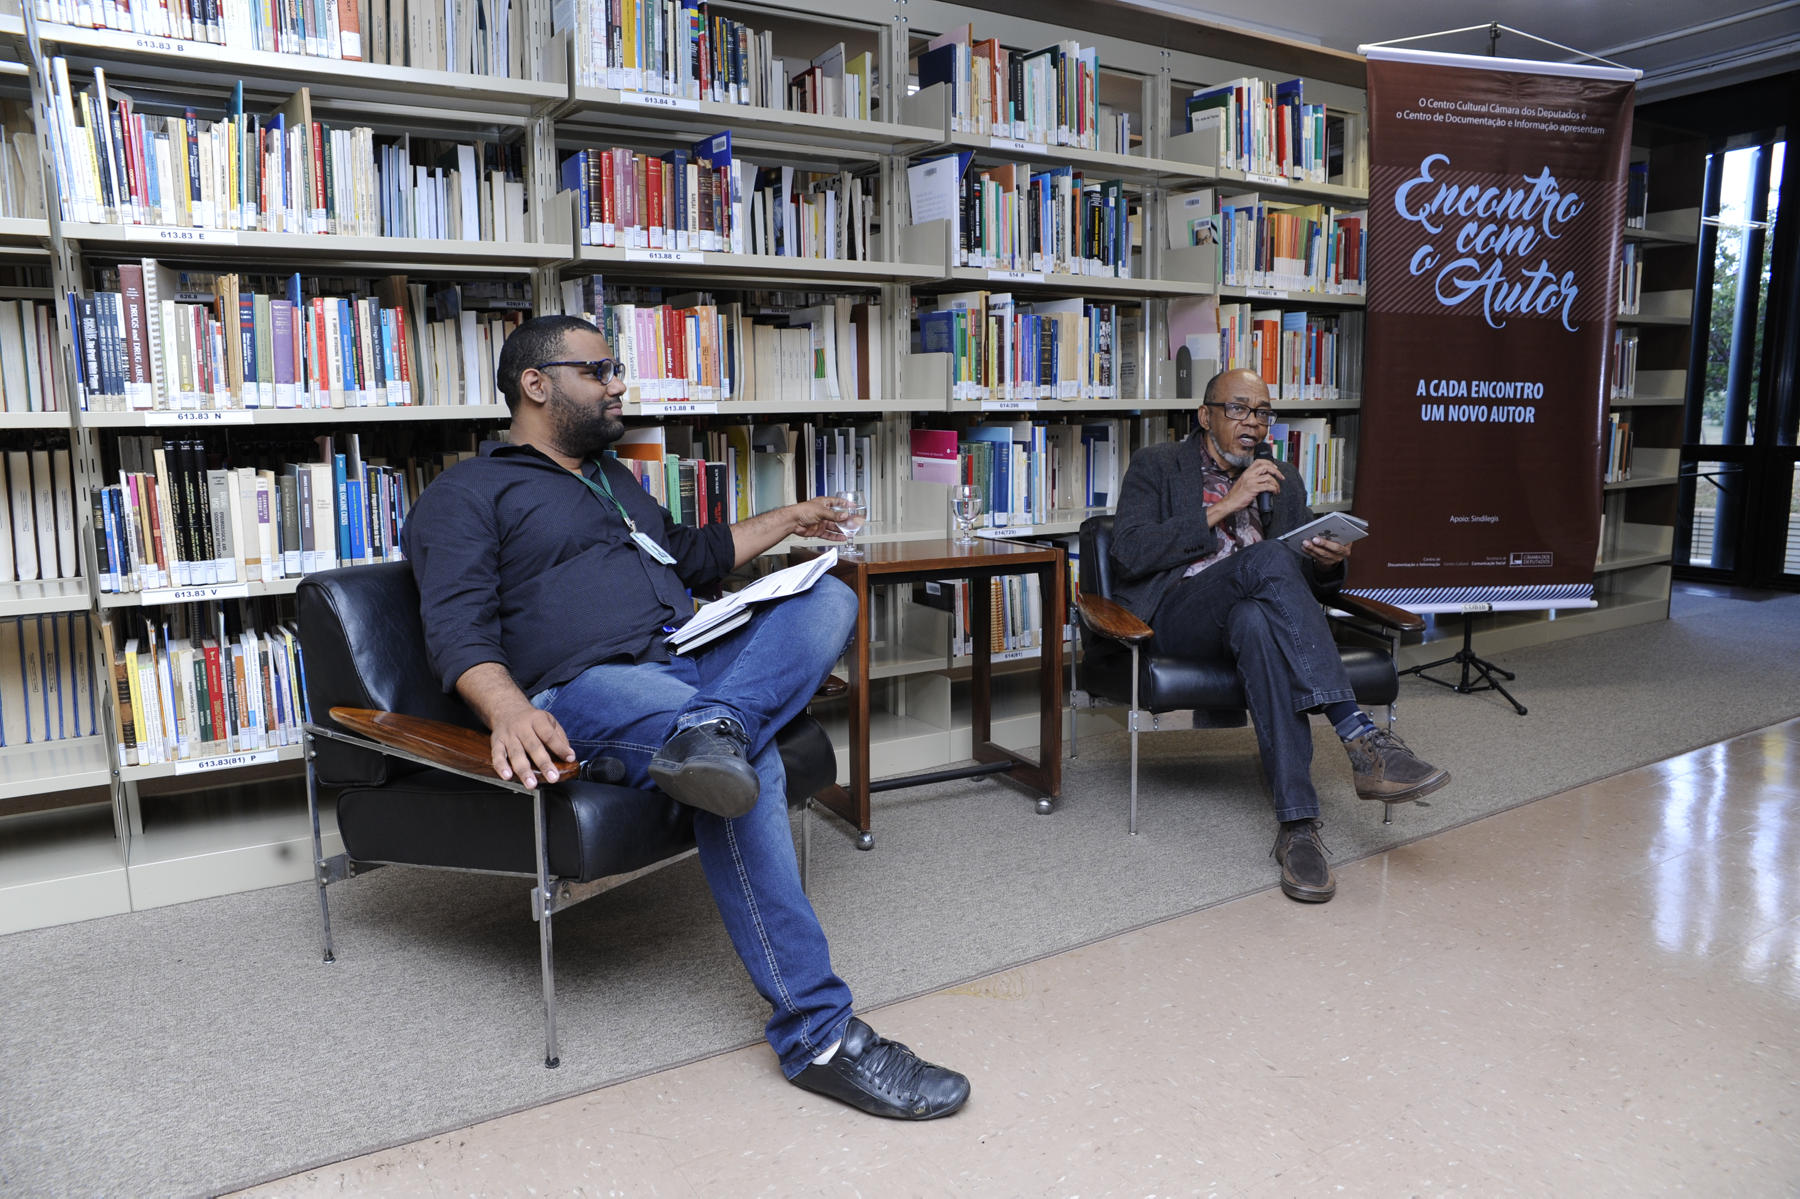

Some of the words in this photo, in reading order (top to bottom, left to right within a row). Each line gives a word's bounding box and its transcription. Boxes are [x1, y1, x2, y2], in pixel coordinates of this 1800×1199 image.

[136, 39, 171, 50] 613.83
[177, 44, 184, 52] B
[644, 97, 668, 105] 613.84
[1418, 98, 1426, 107] O
[1427, 98, 1455, 110] Centro
[1456, 101, 1488, 112] Cultural
[1489, 103, 1519, 115] Câmara
[1521, 107, 1536, 116] dos
[1537, 107, 1580, 119] Deputados
[1396, 111, 1402, 119] o
[1403, 110, 1431, 121] Centro
[1433, 112, 1443, 122] de
[1445, 113, 1506, 128] Documentação
[1514, 119, 1558, 132] Informação
[1560, 124, 1605, 135] apresentam
[1394, 153, 1585, 240] Encontro
[160, 231, 193, 240] 613.83
[199, 232, 205, 240] E
[1456, 220, 1541, 257] com
[1409, 245, 1440, 276] o
[1435, 257, 1580, 332] Autor
[130, 304, 139, 328] DRUGS
[131, 329, 140, 341] and
[133, 342, 142, 362] DRUG
[135, 364, 144, 383] ABUS
[1416, 379, 1427, 396] A
[1429, 380, 1468, 398] CADA
[1471, 381, 1544, 400] ENCONTRO
[214, 412, 222, 420] N
[1421, 404, 1445, 422] UM
[1448, 405, 1488, 422] NOVO
[1490, 406, 1535, 423] AUTOR
[339, 483, 347, 492] THE
[340, 493, 348, 511] COCAINE
[1450, 515, 1469, 524] Apoio:
[198, 757, 246, 768] 613.83(81)
